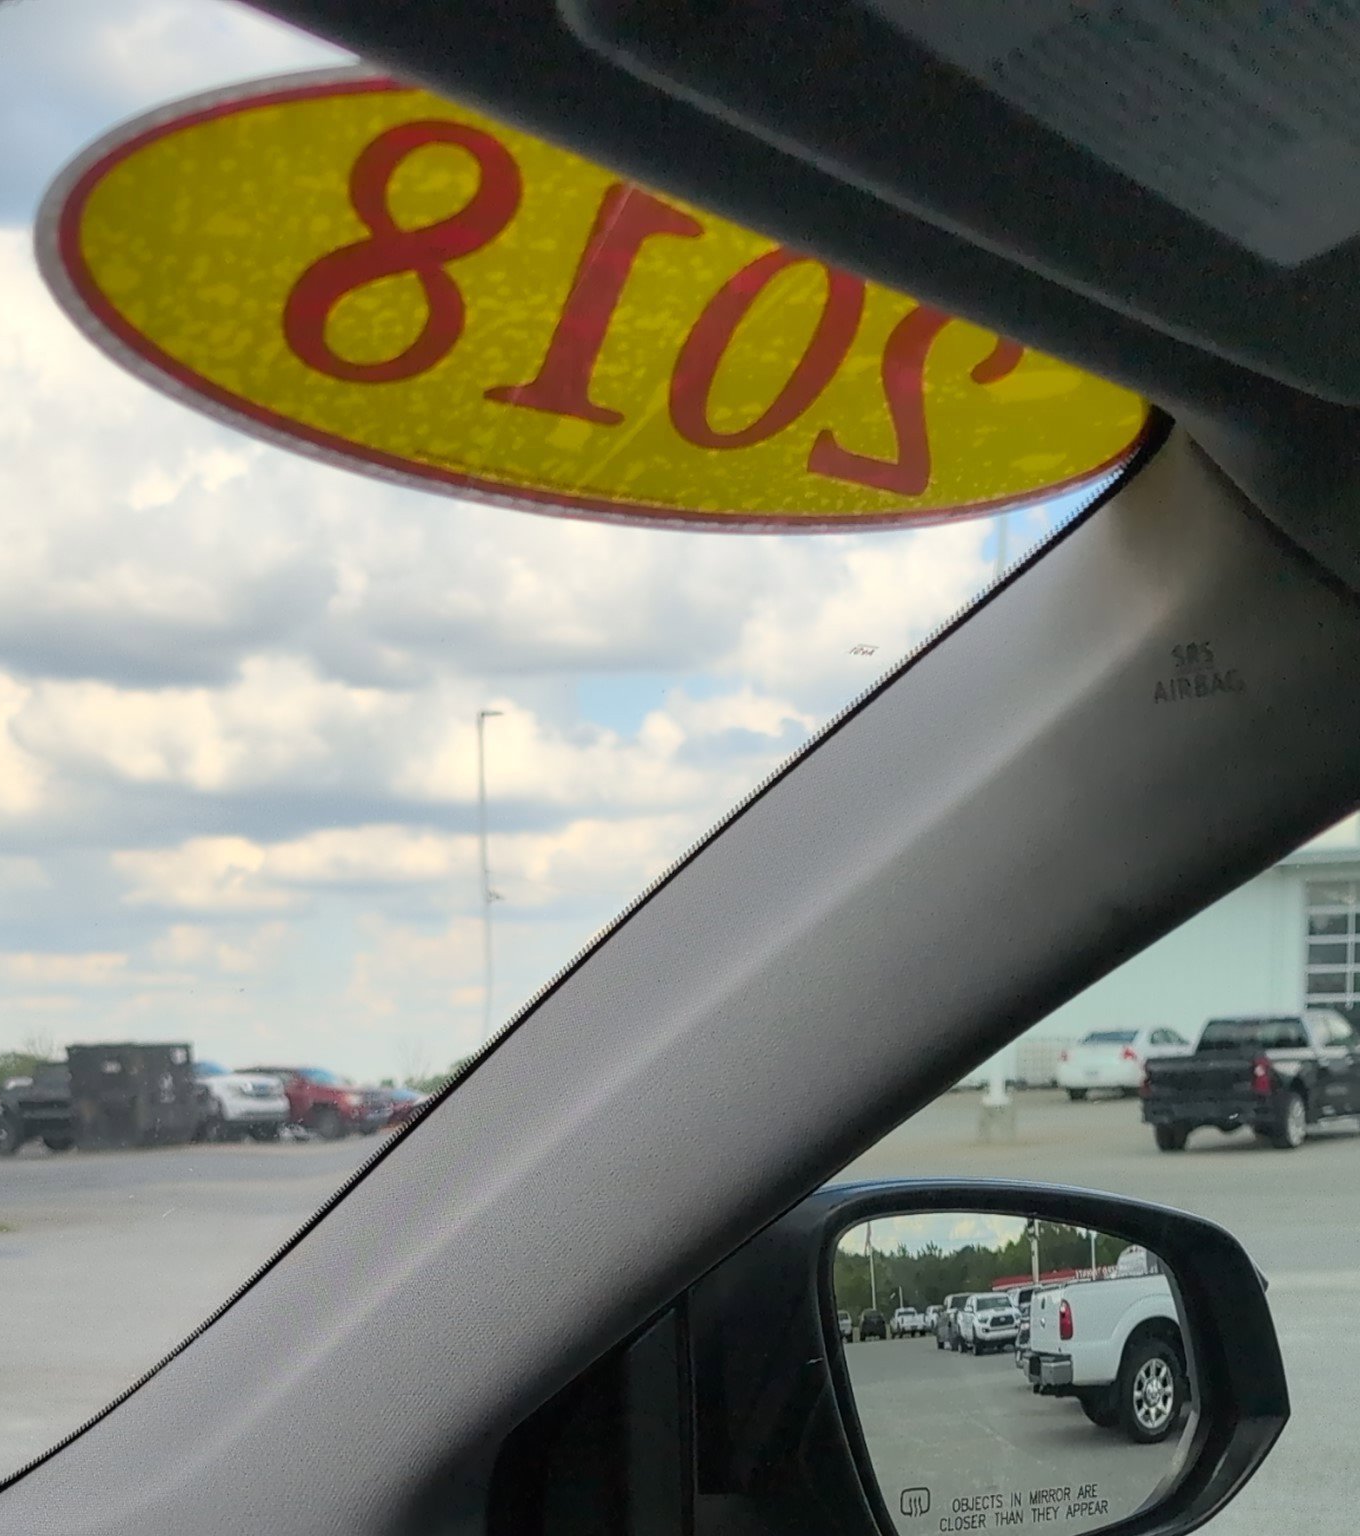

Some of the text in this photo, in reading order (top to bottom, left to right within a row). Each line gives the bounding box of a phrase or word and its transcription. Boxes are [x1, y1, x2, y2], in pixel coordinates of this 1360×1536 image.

[1154, 668, 1245, 704] AIRBAG
[952, 1484, 1098, 1513] OBJECTS IN MIRROR ARE
[939, 1500, 1109, 1532] CLOSER THAN THEY APPEAR
